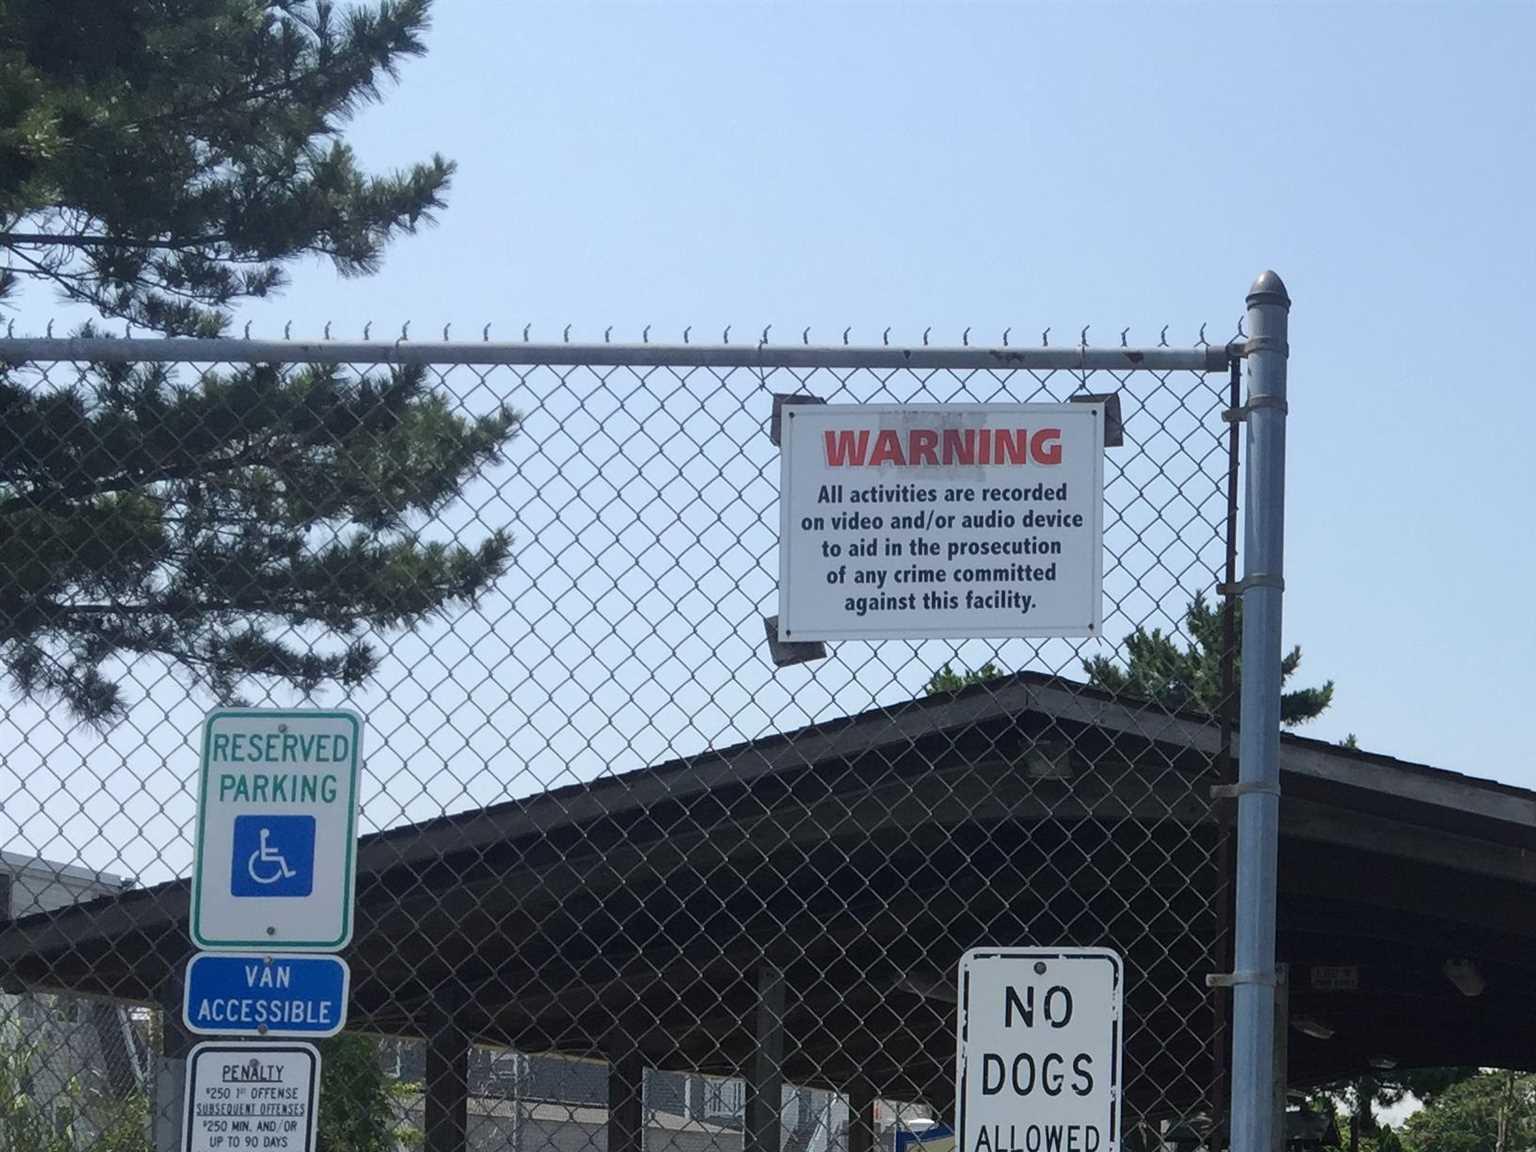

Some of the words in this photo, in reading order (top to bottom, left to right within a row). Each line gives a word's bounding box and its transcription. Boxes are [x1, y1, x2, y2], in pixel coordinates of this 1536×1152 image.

[824, 428, 1062, 467] WARNING
[818, 485, 842, 503] All
[850, 484, 937, 503] activities
[944, 488, 974, 502] are
[982, 483, 1067, 501] recorded
[801, 515, 824, 531] on
[832, 512, 883, 530] video
[890, 511, 955, 531] and/or
[962, 511, 1015, 528] audio
[1023, 510, 1083, 528] device
[822, 541, 841, 557] to
[848, 539, 878, 557] aid
[885, 539, 902, 556] in
[909, 538, 940, 556] the
[948, 537, 1061, 561] prosecution
[827, 566, 846, 584] of
[854, 570, 887, 588] any
[894, 565, 946, 583] crime
[953, 564, 1056, 582] committed
[845, 592, 916, 616] against
[922, 592, 958, 610] this
[966, 591, 1036, 614] facility.
[212, 733, 349, 763] RESERVED
[219, 774, 337, 804] PARKING
[244, 964, 290, 989] VAN
[198, 999, 332, 1025] ACCESSIBLE
[1004, 985, 1074, 1028] NO
[222, 1065, 284, 1081] PENALTY
[982, 1053, 1094, 1096] DOGS
[206, 1088, 231, 1099] $250
[251, 1088, 298, 1100] OFFENSE
[196, 1103, 256, 1114] SUBSEQUENT
[260, 1103, 305, 1114] OFFENSES
[202, 1120, 227, 1132] $250
[232, 1121, 251, 1132] MIN.
[257, 1120, 298, 1132] AND/OR
[209, 1136, 223, 1148] UP
[228, 1136, 240, 1148] TO
[245, 1136, 258, 1148] 90
[263, 1136, 288, 1148] DAYS
